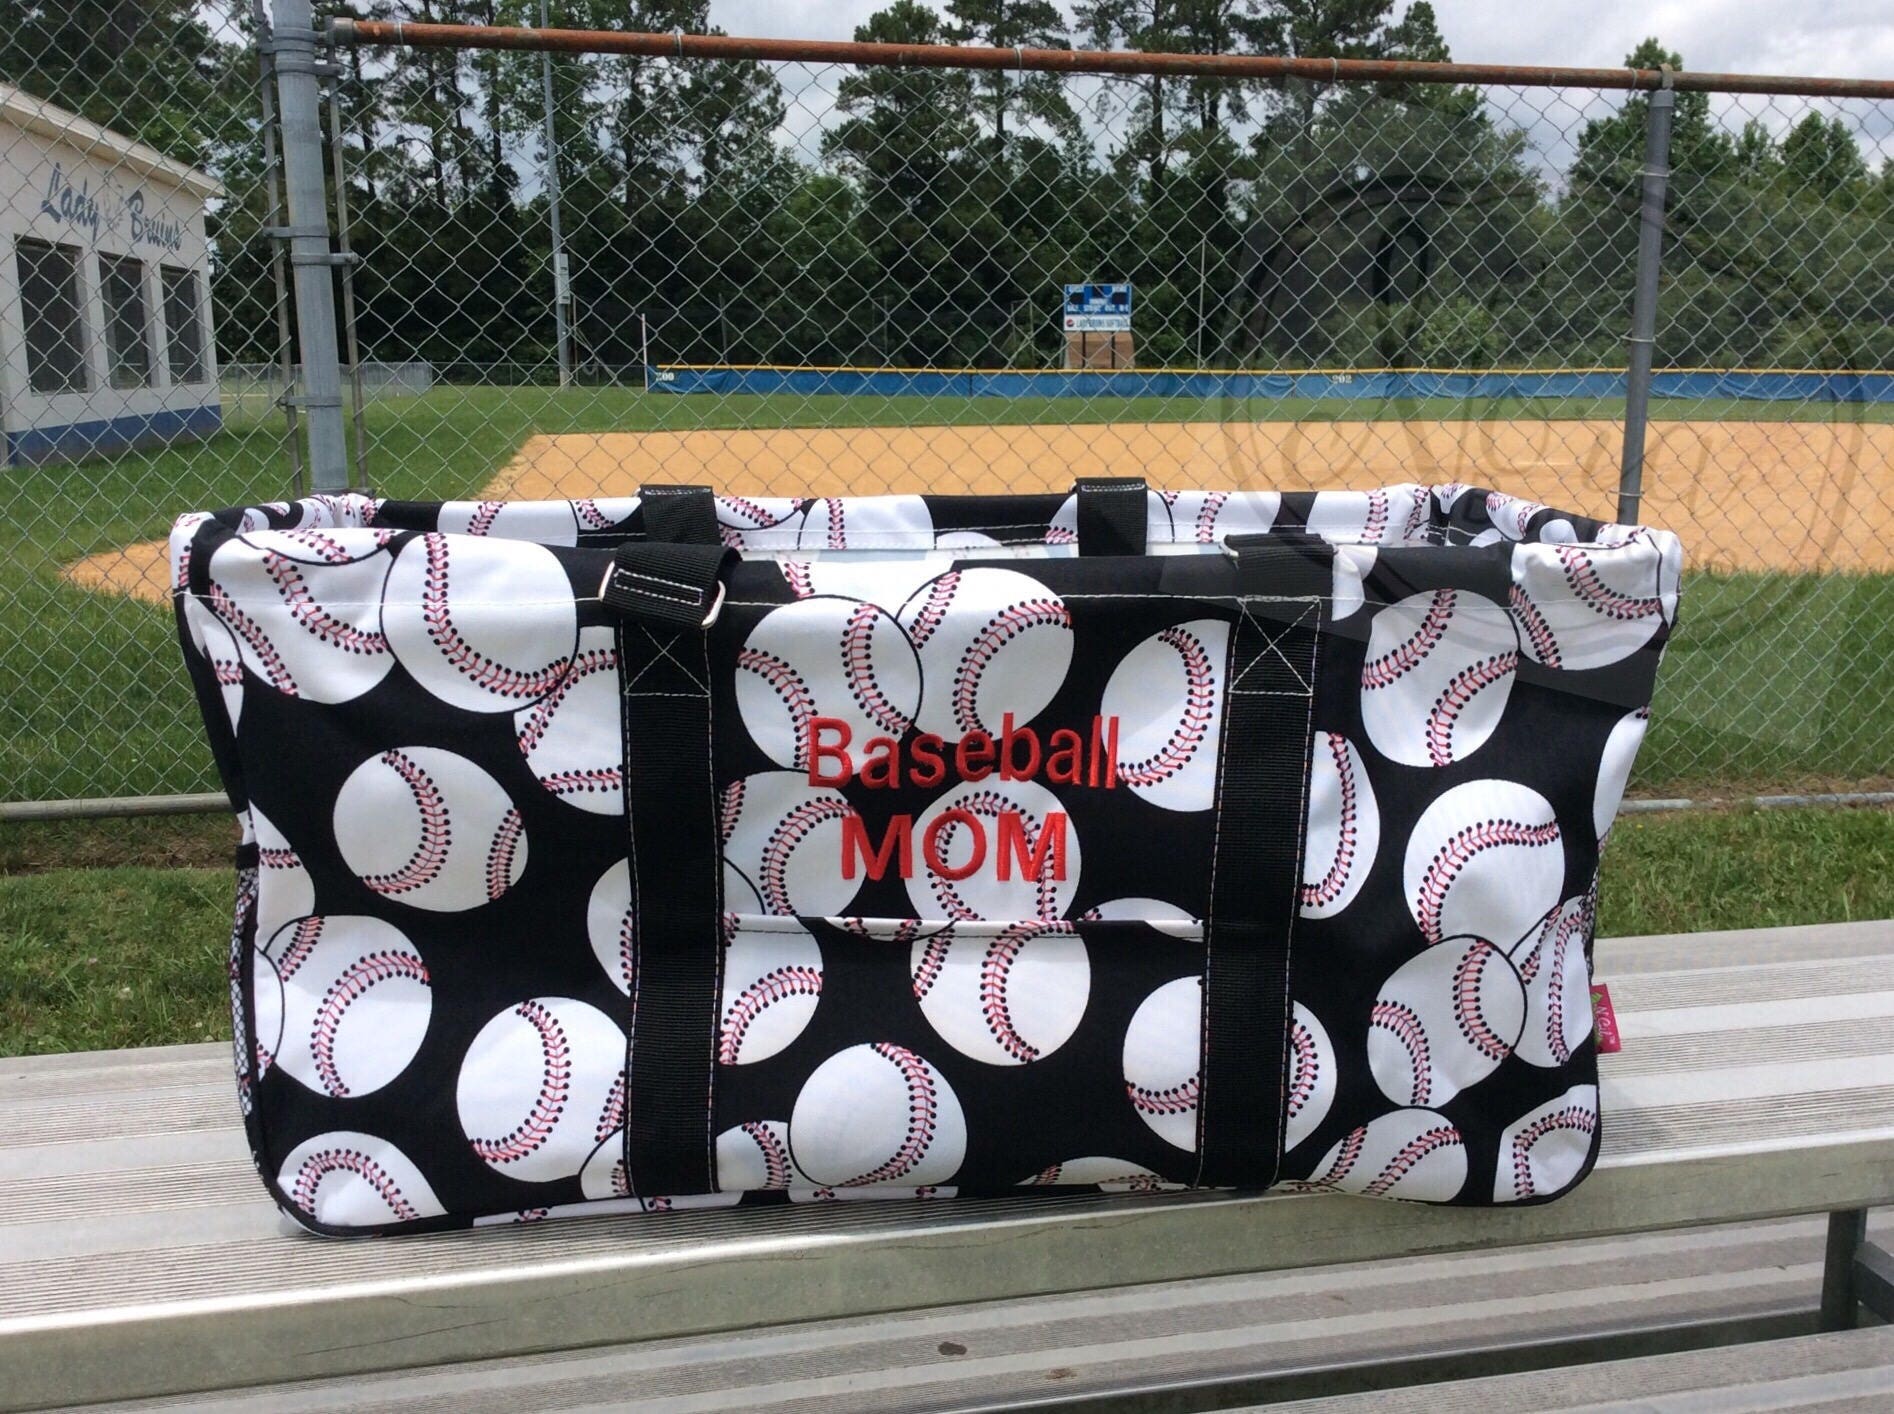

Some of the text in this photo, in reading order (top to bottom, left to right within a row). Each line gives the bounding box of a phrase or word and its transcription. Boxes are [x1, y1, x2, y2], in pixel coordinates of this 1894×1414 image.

[42, 161, 100, 242] Lady
[808, 712, 1119, 789] Baseball
[841, 809, 1067, 882] MOM
